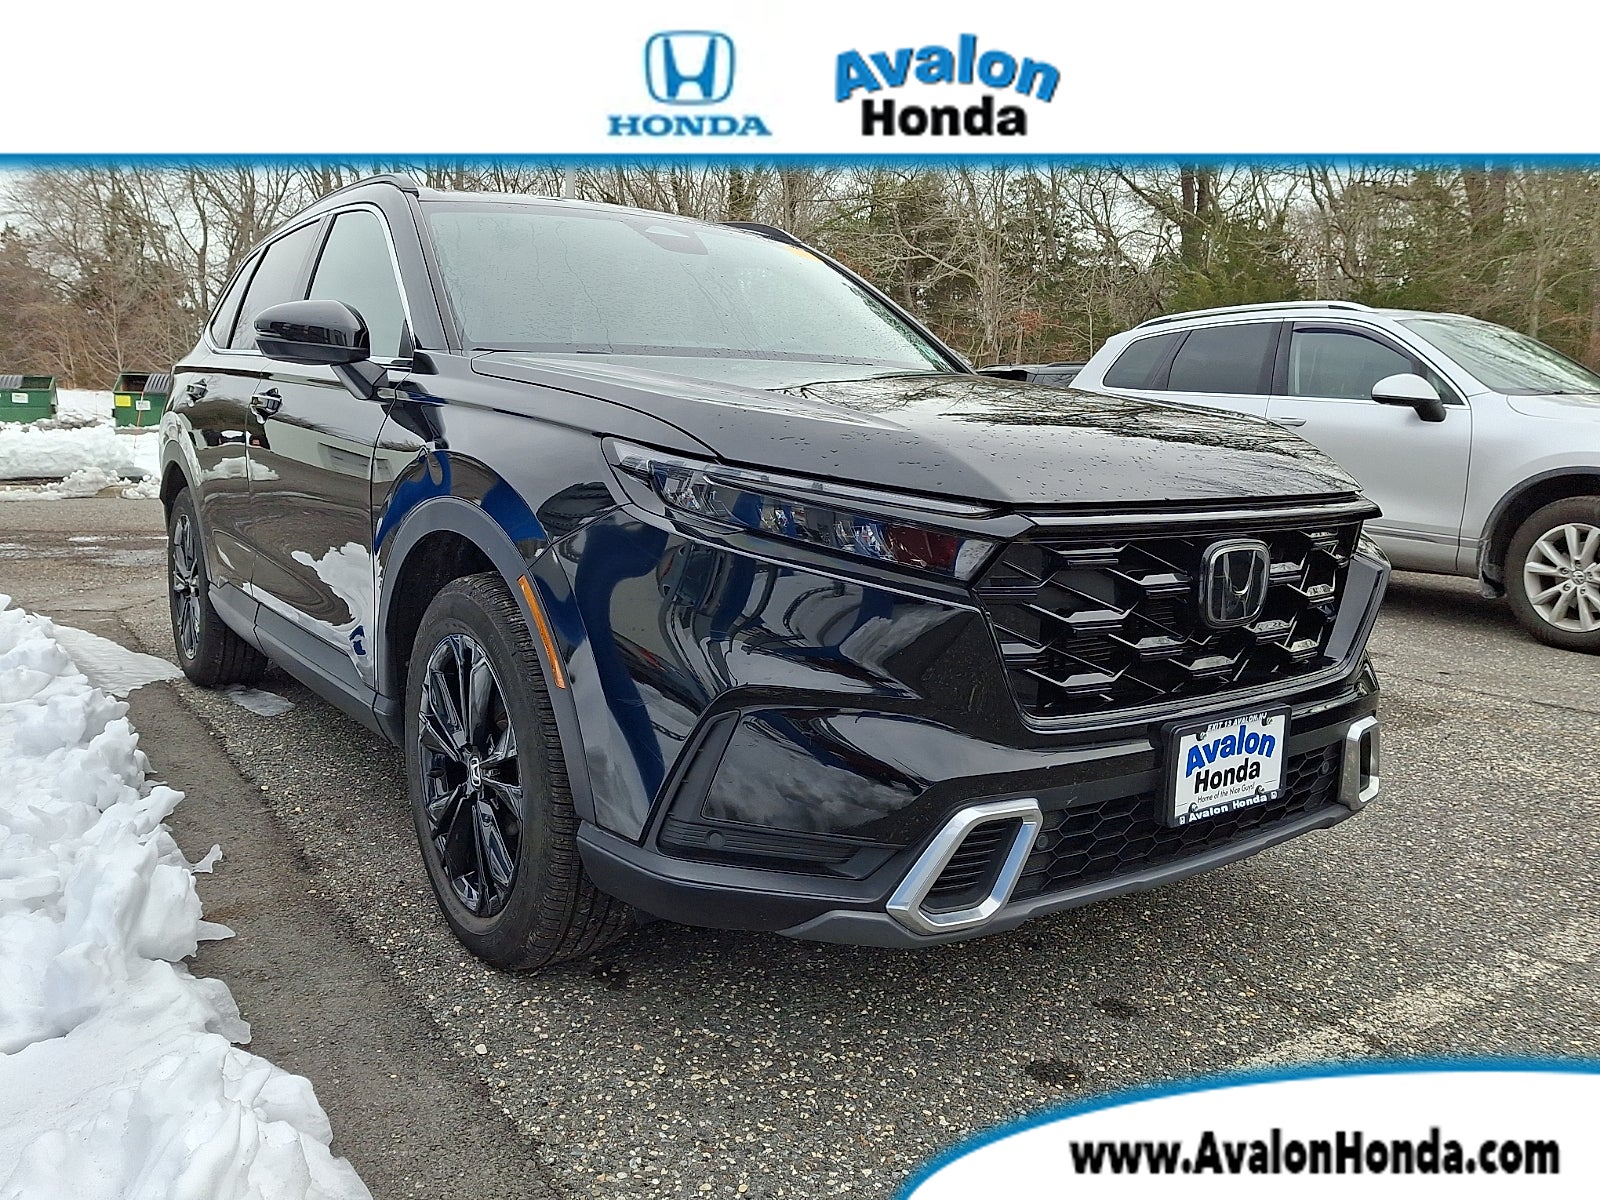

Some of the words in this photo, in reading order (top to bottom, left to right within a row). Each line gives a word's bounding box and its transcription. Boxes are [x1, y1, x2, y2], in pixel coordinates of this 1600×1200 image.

[1207, 721, 1224, 732] EXIT
[1185, 724, 1276, 779] Avalon
[1194, 757, 1261, 795] Honda
[1188, 804, 1229, 822] Avalon
[1232, 794, 1268, 810] Honda
[1197, 794, 1213, 803] Home
[1213, 790, 1220, 799] of
[1220, 789, 1229, 797] the
[1229, 786, 1241, 796] Nice
